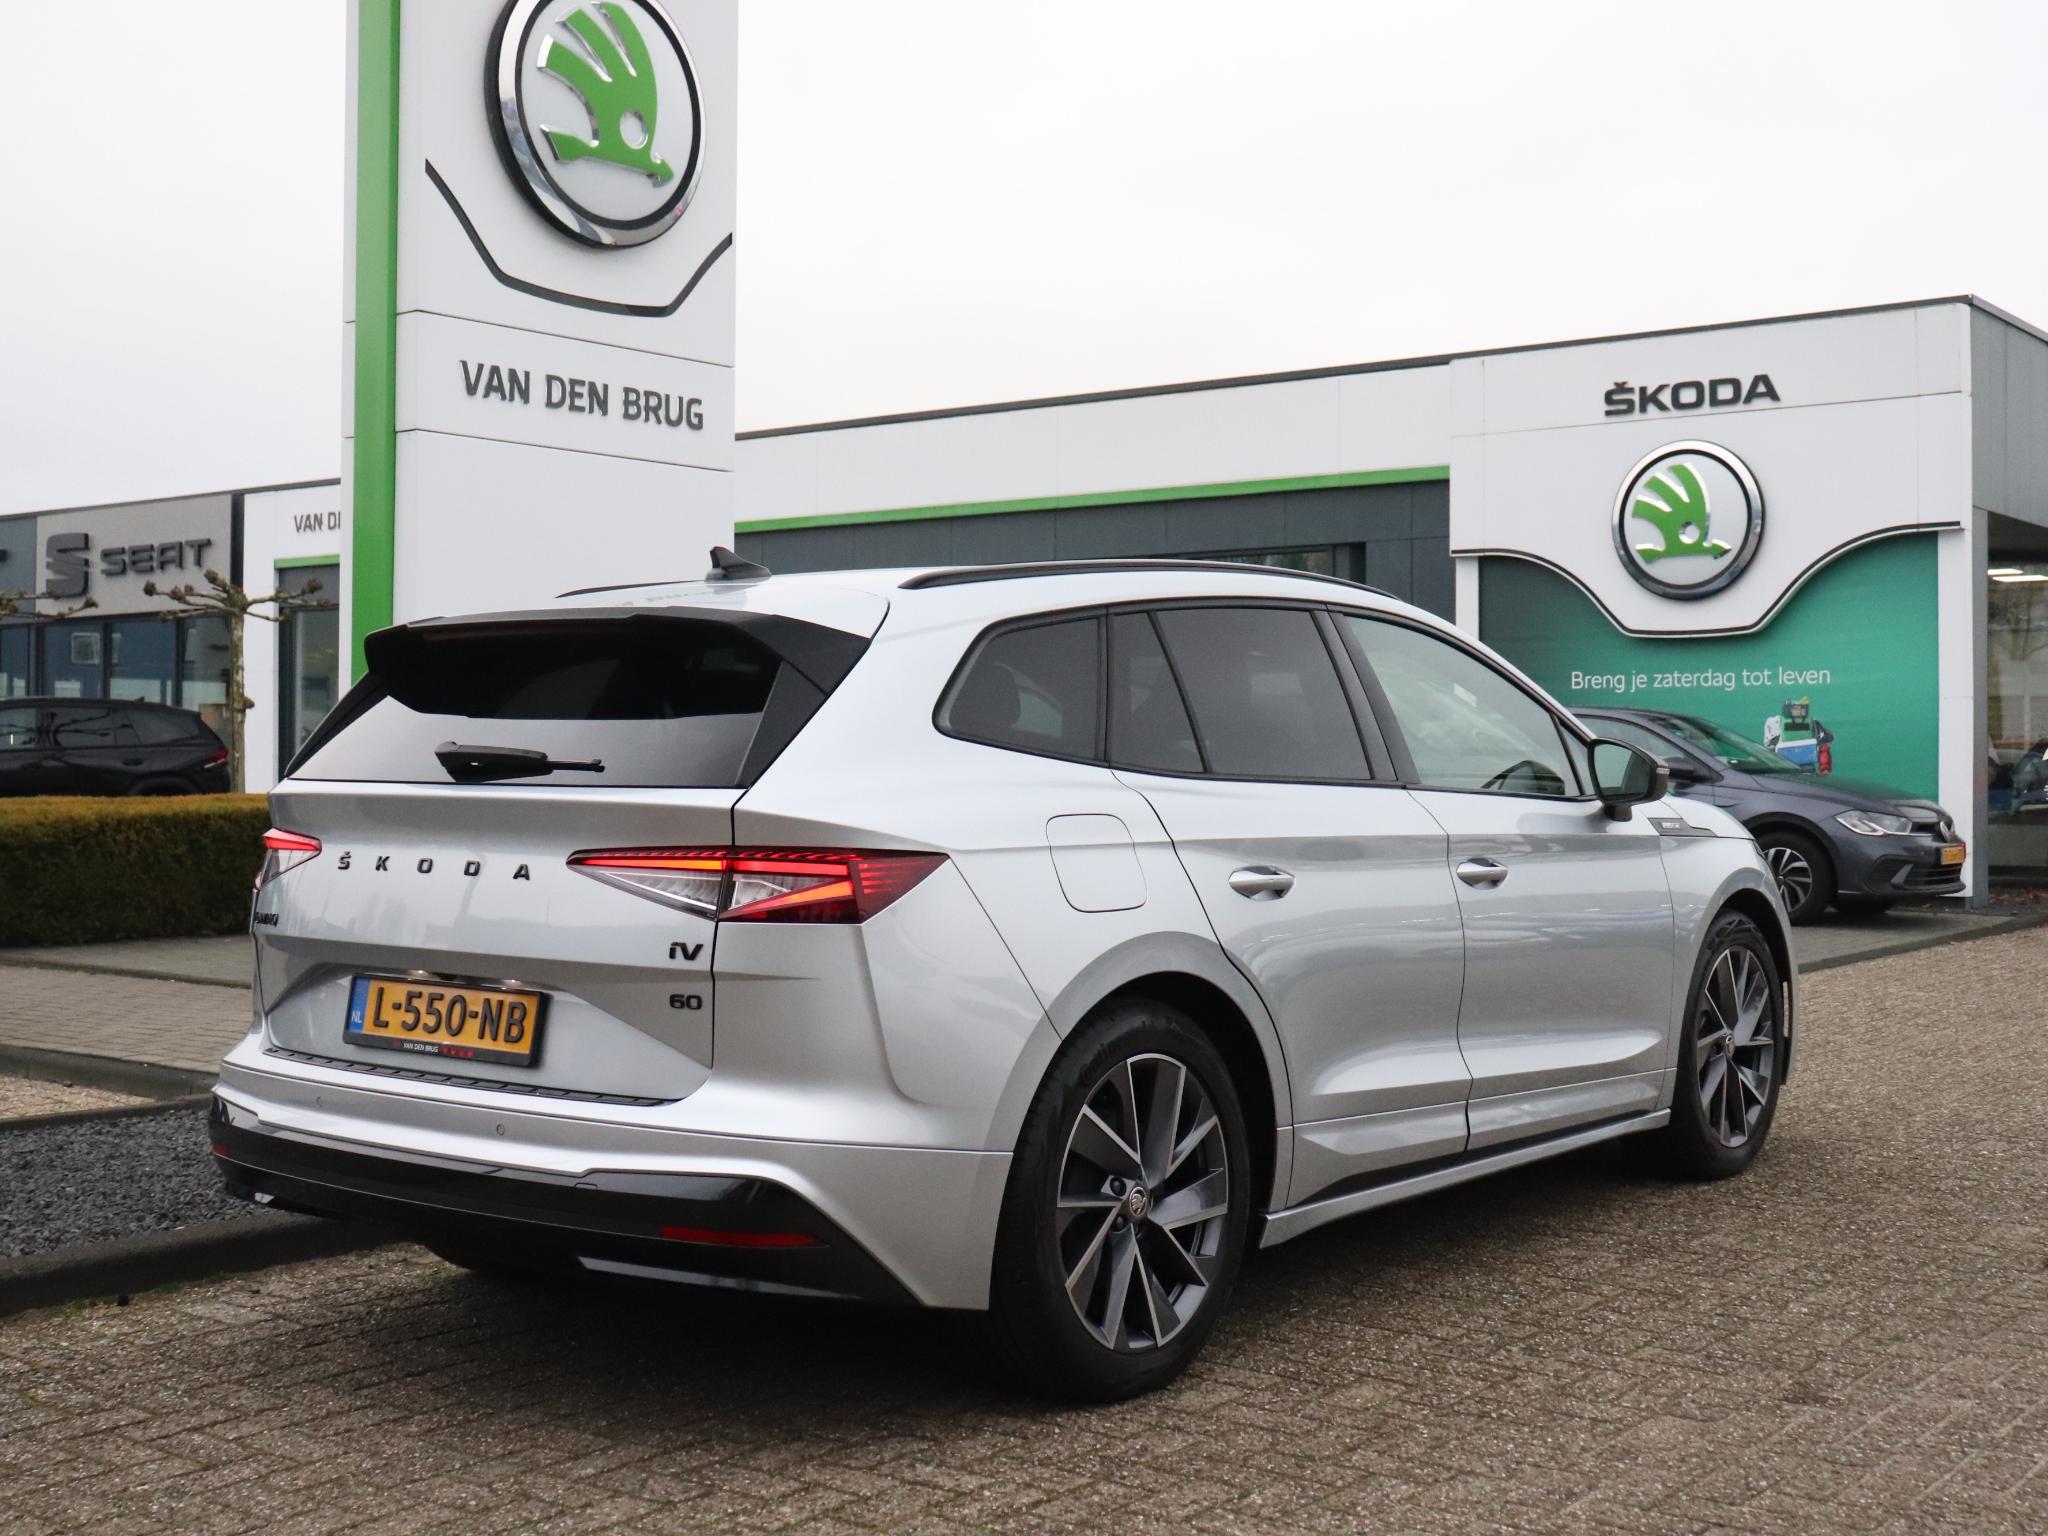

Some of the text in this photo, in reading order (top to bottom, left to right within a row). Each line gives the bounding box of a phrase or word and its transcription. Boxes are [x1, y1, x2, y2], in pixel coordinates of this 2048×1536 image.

[460, 359, 704, 431] VAN DEN BRUG
[1604, 373, 1781, 417] ŠKODA
[294, 511, 341, 533] VAN D
[100, 538, 212, 577] SEAT
[1571, 666, 1831, 693] Breng je zaterdag tot leven
[351, 1010, 363, 1024] NL
[372, 986, 528, 1044] L-550-NB
[669, 993, 703, 1010] 60
